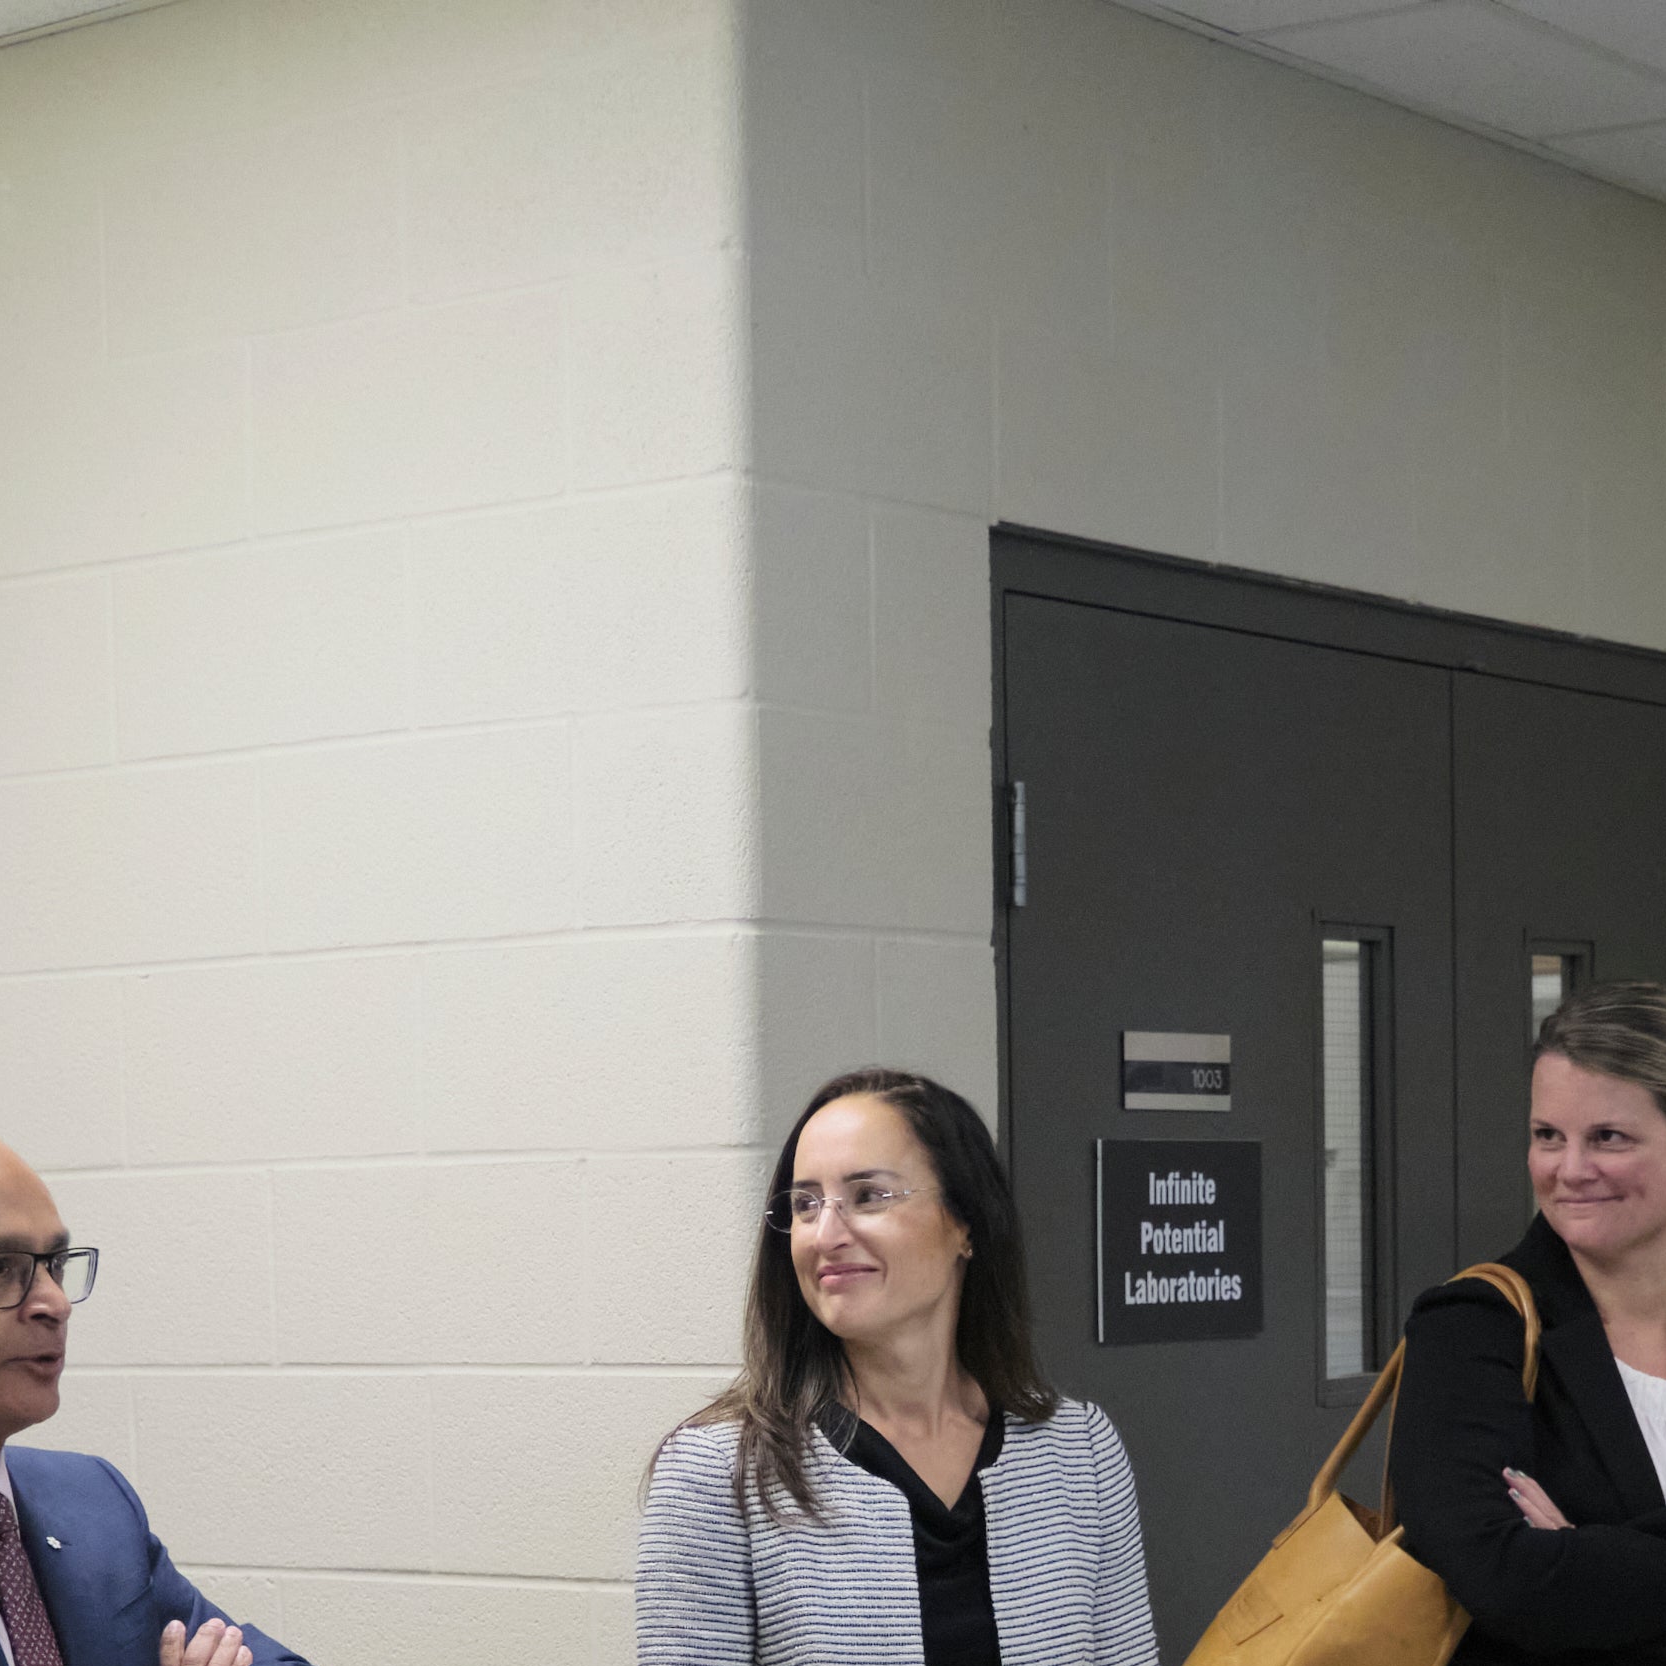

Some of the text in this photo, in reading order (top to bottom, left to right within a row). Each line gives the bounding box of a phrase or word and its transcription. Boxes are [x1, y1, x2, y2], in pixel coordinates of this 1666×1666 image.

[1191, 1069, 1223, 1089] 1003
[1149, 1171, 1216, 1205] Infinite
[1140, 1220, 1224, 1254] Potential
[1124, 1268, 1242, 1305] Laboratories
